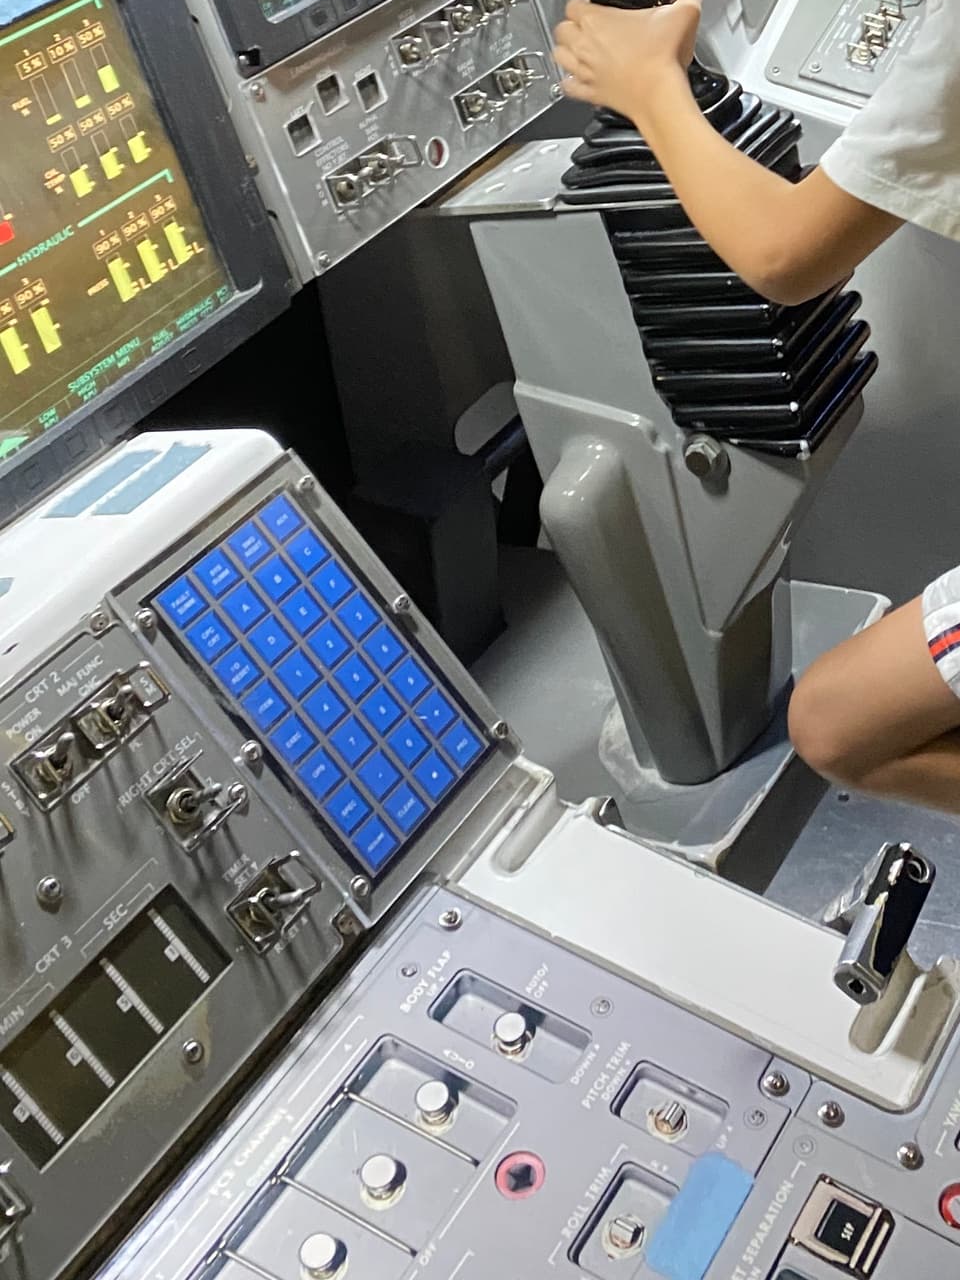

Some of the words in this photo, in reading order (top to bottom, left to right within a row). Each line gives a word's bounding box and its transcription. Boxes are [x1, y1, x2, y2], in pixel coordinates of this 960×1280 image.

[16, 224, 75, 268] HYDRAULIC
[68, 348, 117, 393] SUBSYSTEM
[116, 336, 142, 359] MENU
[171, 590, 191, 609] FAULT
[241, 603, 251, 613] A
[299, 607, 308, 617] E
[267, 636, 276, 646] D
[25, 679, 50, 704] CRT
[50, 671, 62, 684] 2
[56, 677, 79, 697] MAJ
[76, 655, 104, 680] FUNC
[78, 674, 102, 698] GNC
[5, 707, 43, 740] POWER
[25, 725, 43, 742] ON
[118, 773, 154, 809] RIGHT
[175, 733, 197, 754] SEL
[71, 783, 93, 805] OFF
[397, 797, 417, 819] CLEAR
[103, 903, 129, 932] SEC
[35, 945, 63, 975] CRT
[61, 935, 73, 950] 3
[400, 979, 429, 1014] BODY
[426, 949, 452, 982] FLAP
[533, 979, 551, 1000] OFF
[569, 1050, 598, 1087] DOWN
[580, 1073, 610, 1110] PITCH
[605, 1040, 632, 1076] TRIM
[601, 1066, 627, 1103] DOWN
[716, 1133, 728, 1150] UP
[560, 1203, 589, 1239] ROLL
[584, 1167, 614, 1205] TRIM
[742, 1179, 795, 1265] SEPARATION
[841, 1222, 856, 1241] SEP
[419, 1241, 437, 1267] OFF
